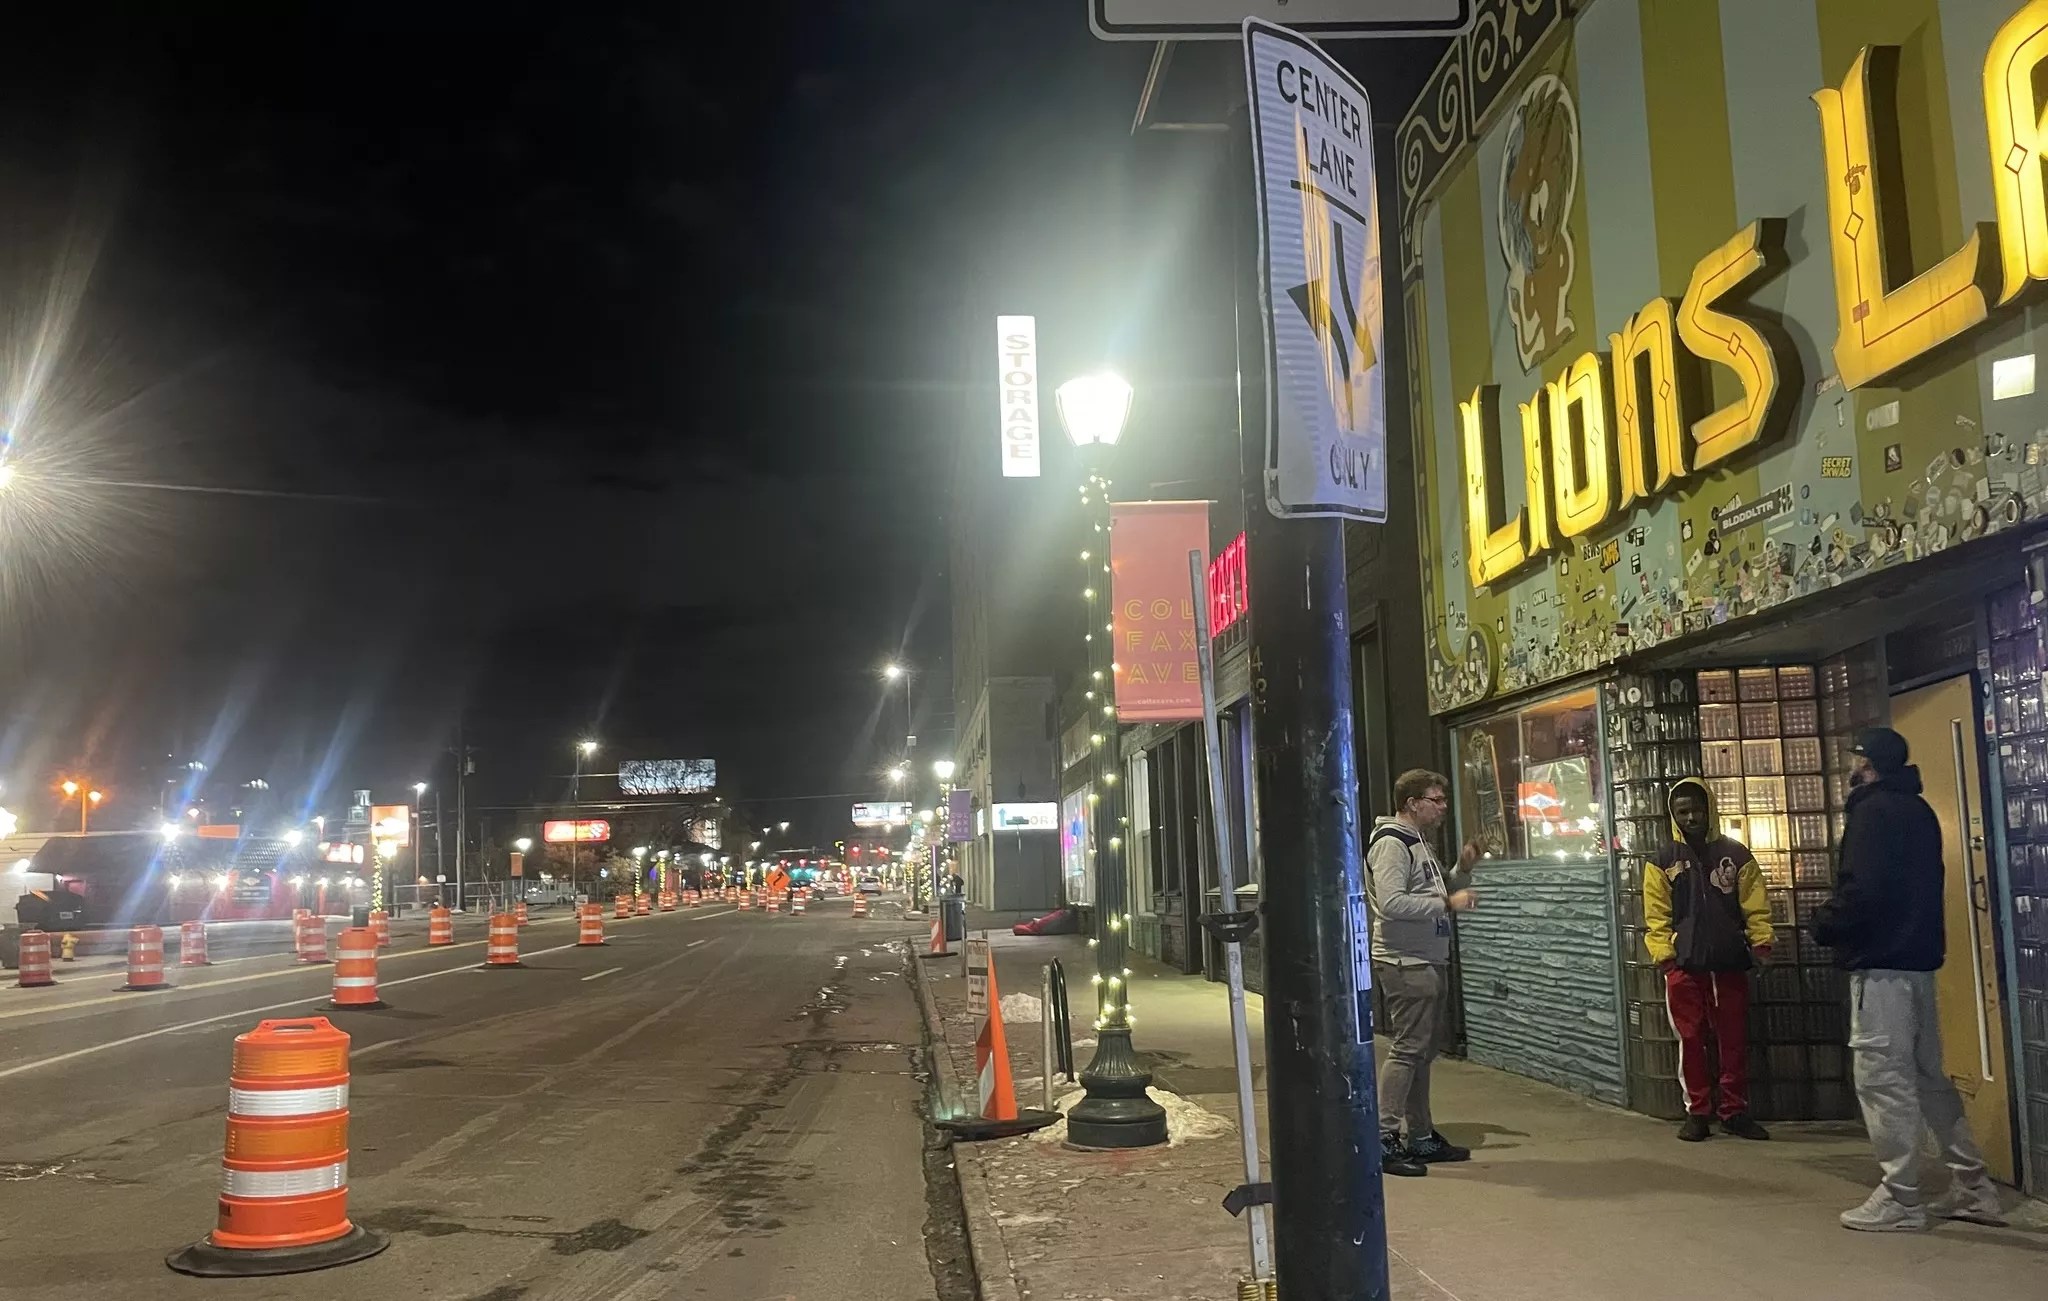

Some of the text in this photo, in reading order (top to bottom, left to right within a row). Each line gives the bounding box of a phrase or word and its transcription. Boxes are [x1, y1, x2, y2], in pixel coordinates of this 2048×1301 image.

[1277, 60, 1362, 149] CENTER
[1303, 127, 1357, 198] LANE
[1005, 334, 1033, 459] STORAGE
[1329, 444, 1370, 491] ONLY
[1822, 456, 1852, 468] SECRET
[1124, 598, 1194, 620] COL
[1126, 630, 1196, 653] FAX
[1127, 661, 1200, 685] AVE
